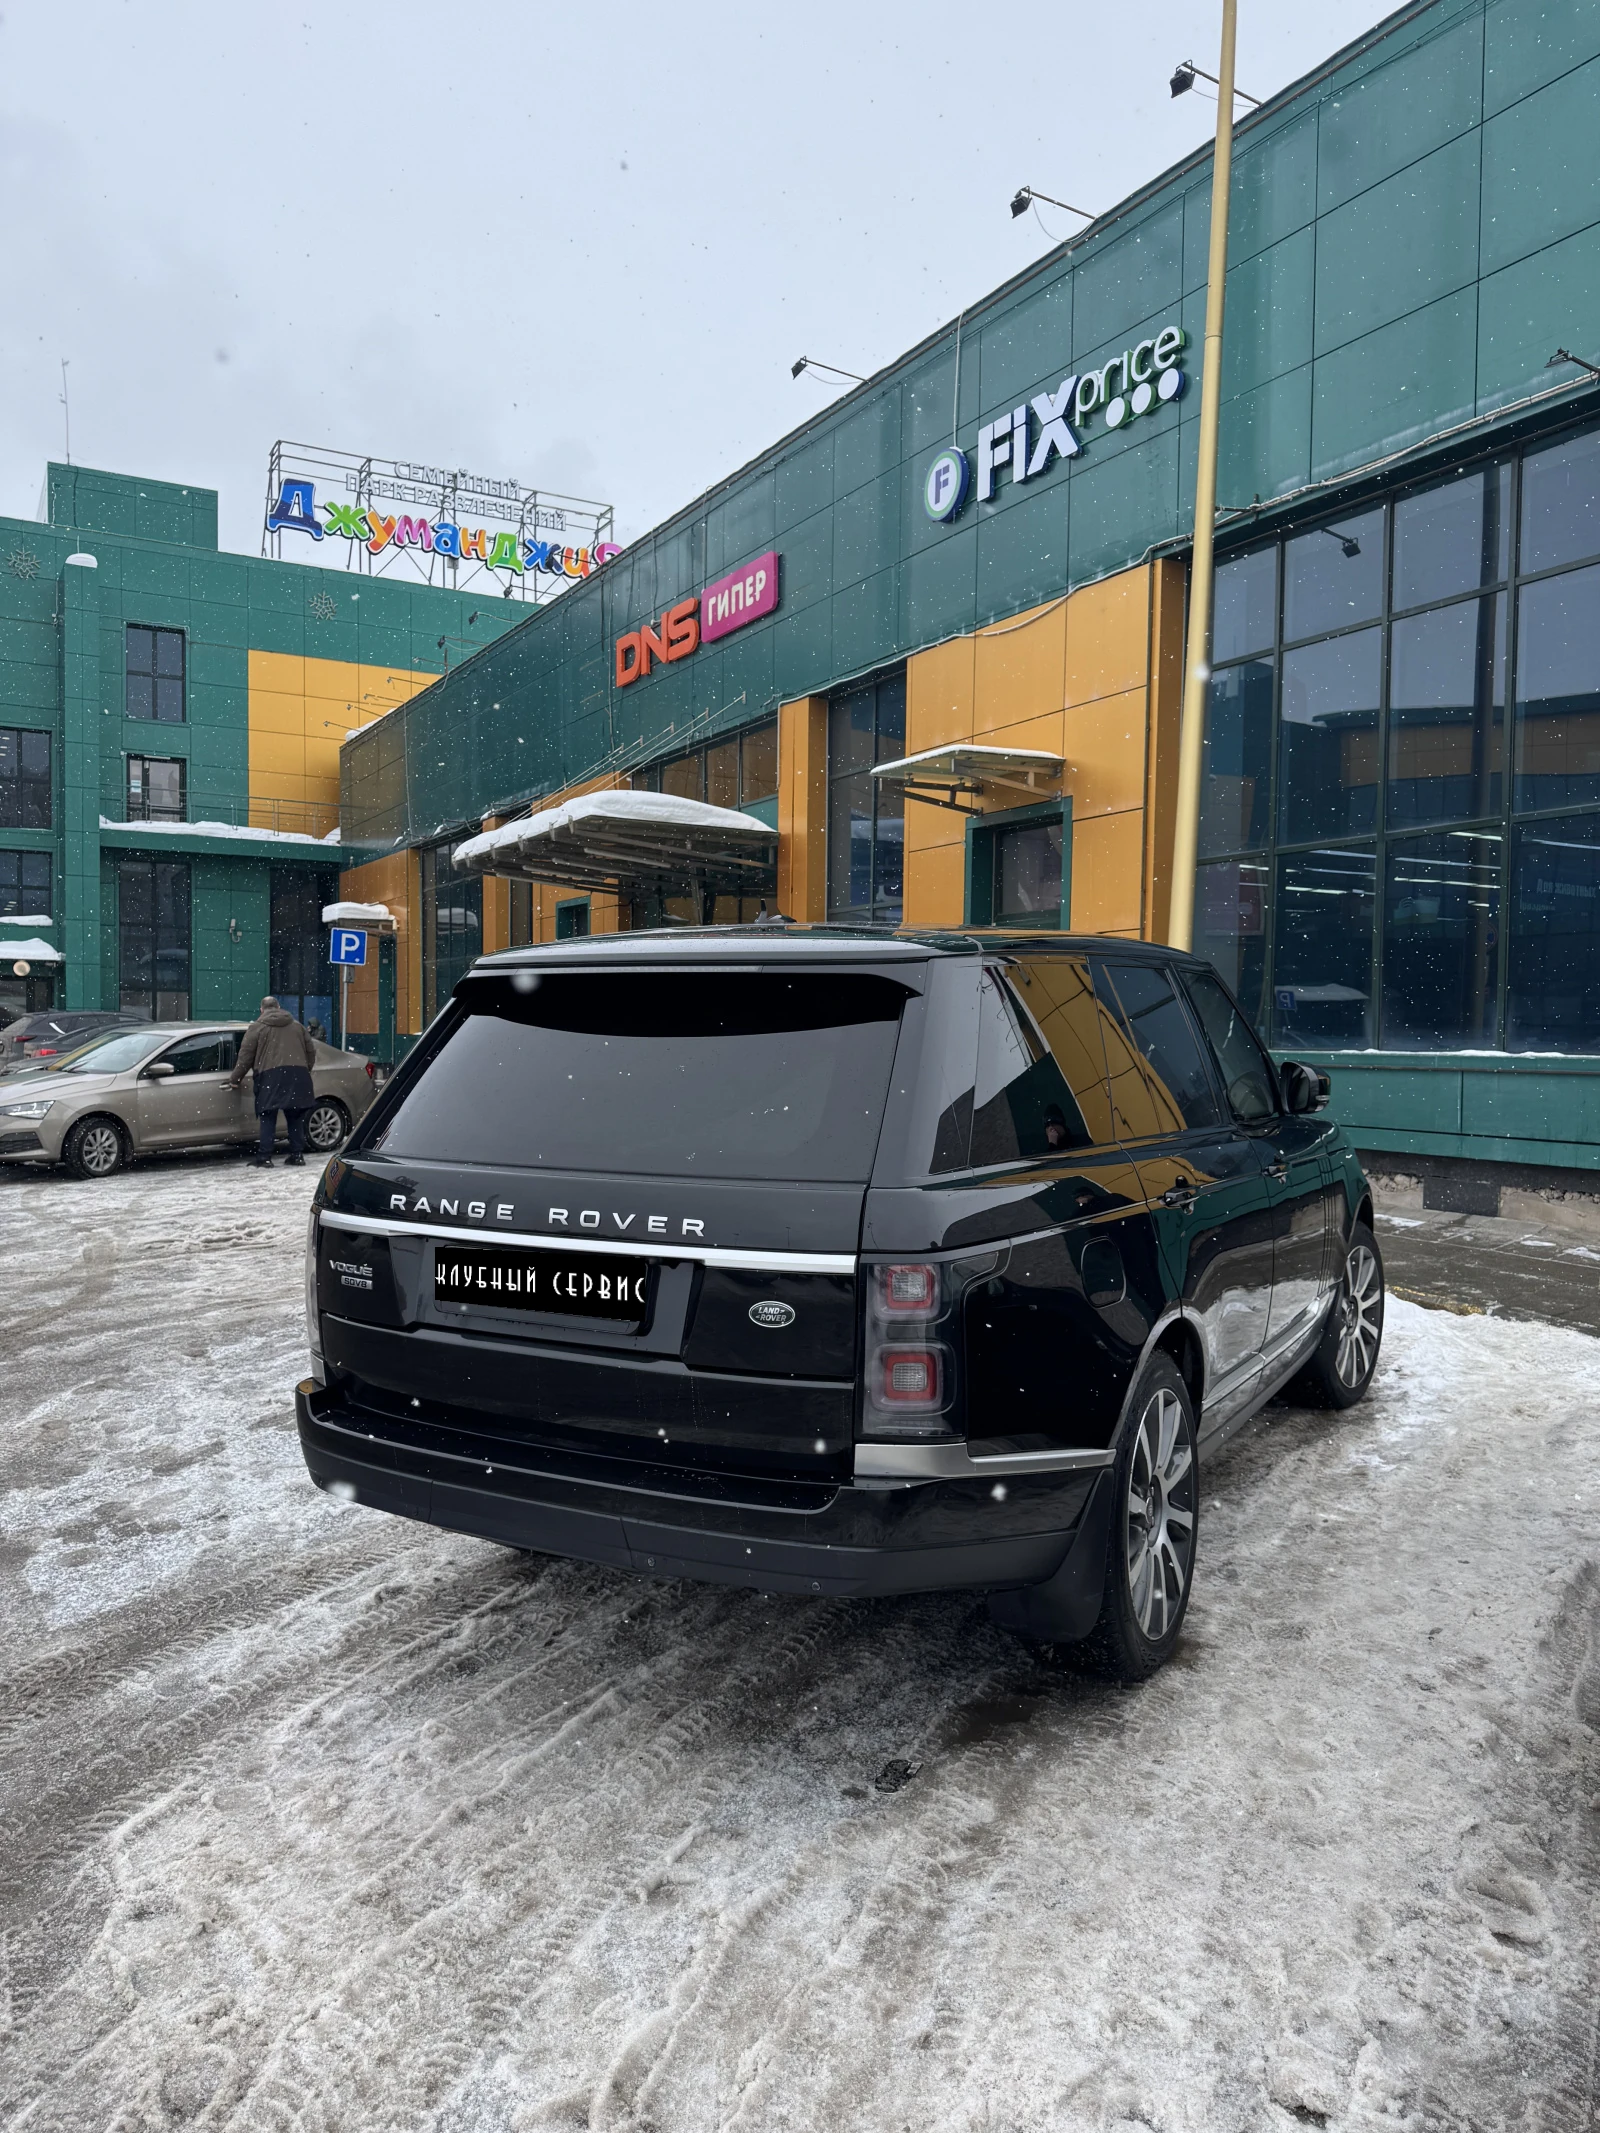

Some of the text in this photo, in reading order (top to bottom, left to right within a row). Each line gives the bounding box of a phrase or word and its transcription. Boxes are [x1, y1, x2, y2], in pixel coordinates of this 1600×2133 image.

[1075, 326, 1185, 427] price
[345, 473, 567, 532] ПАРК РАЗВЛЕЧЕНИЙ
[393, 461, 521, 500] СЕМЕЙНЫЙ
[708, 569, 767, 627] ГИПЕР
[616, 597, 700, 688] DNS
[340, 933, 360, 960] P
[389, 1194, 705, 1237] RANGE ROVER
